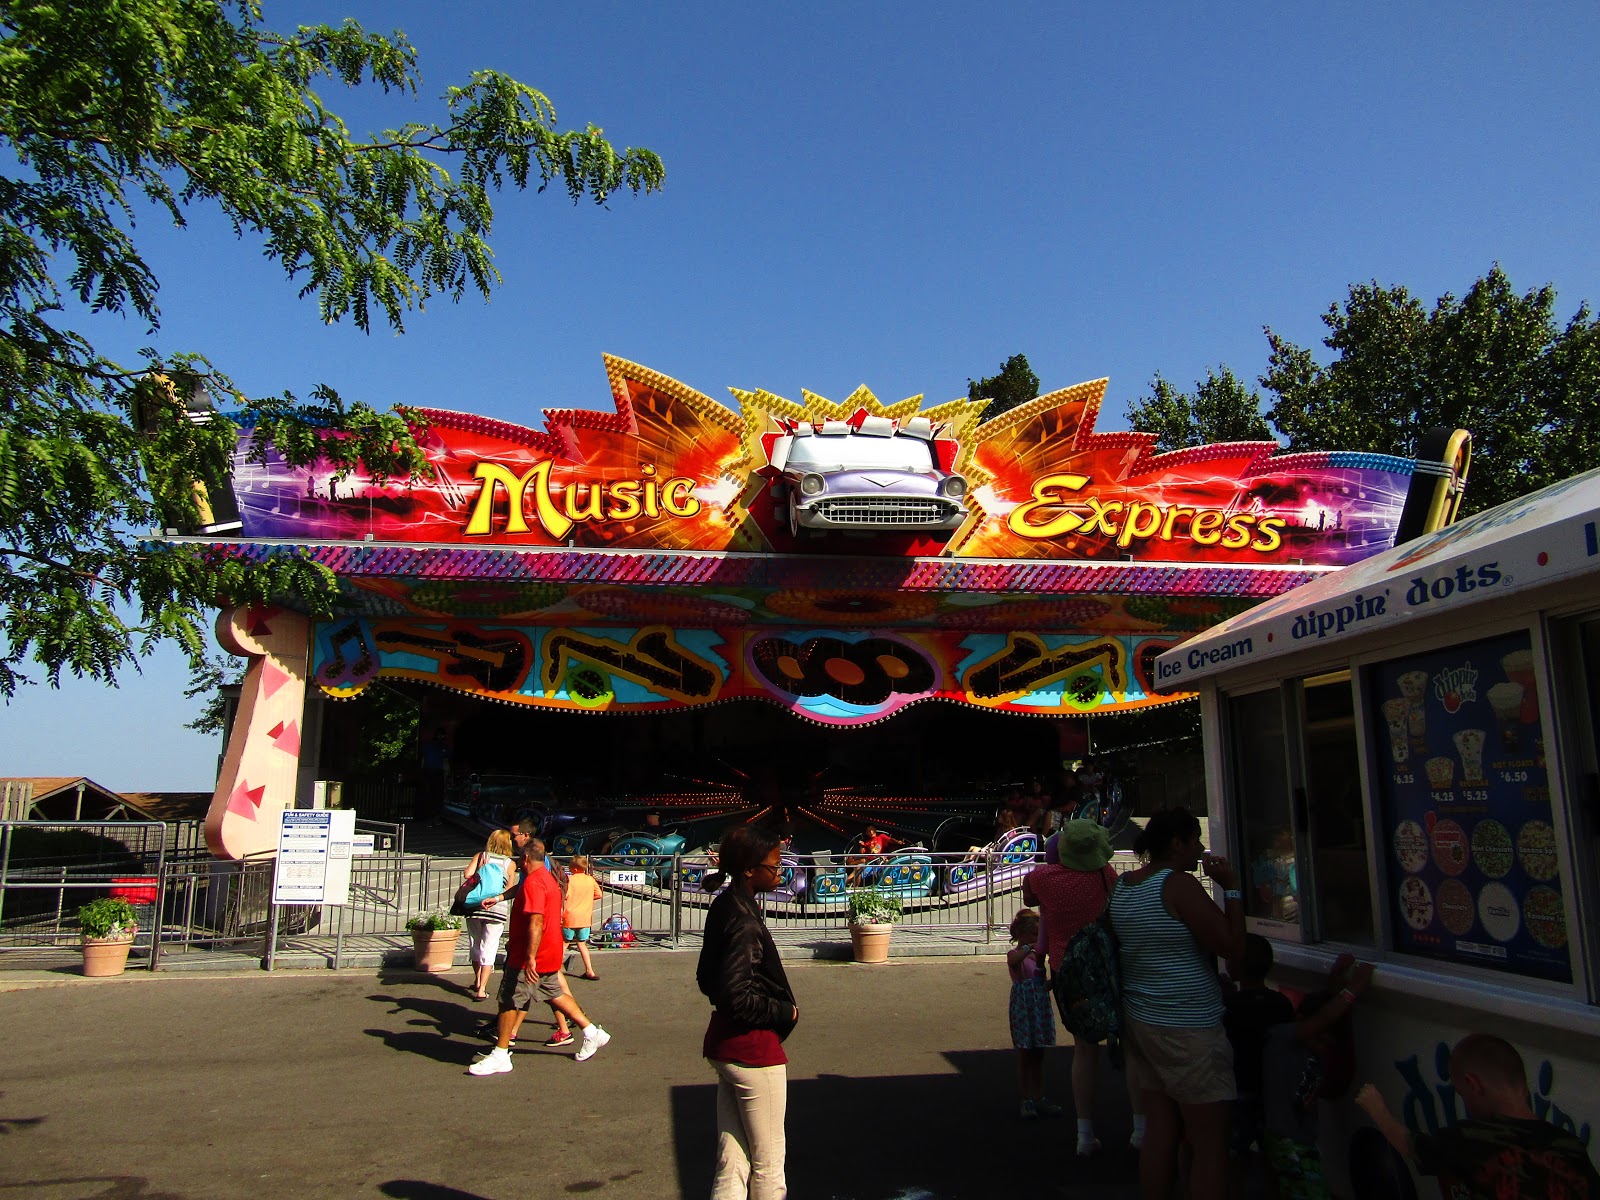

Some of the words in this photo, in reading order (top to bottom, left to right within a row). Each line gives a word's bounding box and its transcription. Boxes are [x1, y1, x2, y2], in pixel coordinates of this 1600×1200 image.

[464, 458, 701, 541] Music
[1007, 472, 1287, 551] Express
[1158, 660, 1181, 679] Ice
[1187, 637, 1252, 670] Cream
[1291, 588, 1390, 639] dippin'
[1393, 775, 1414, 784] $6.25
[1500, 771, 1528, 782] $6.50
[1463, 790, 1488, 801] $5.25
[618, 873, 638, 882] Exit
